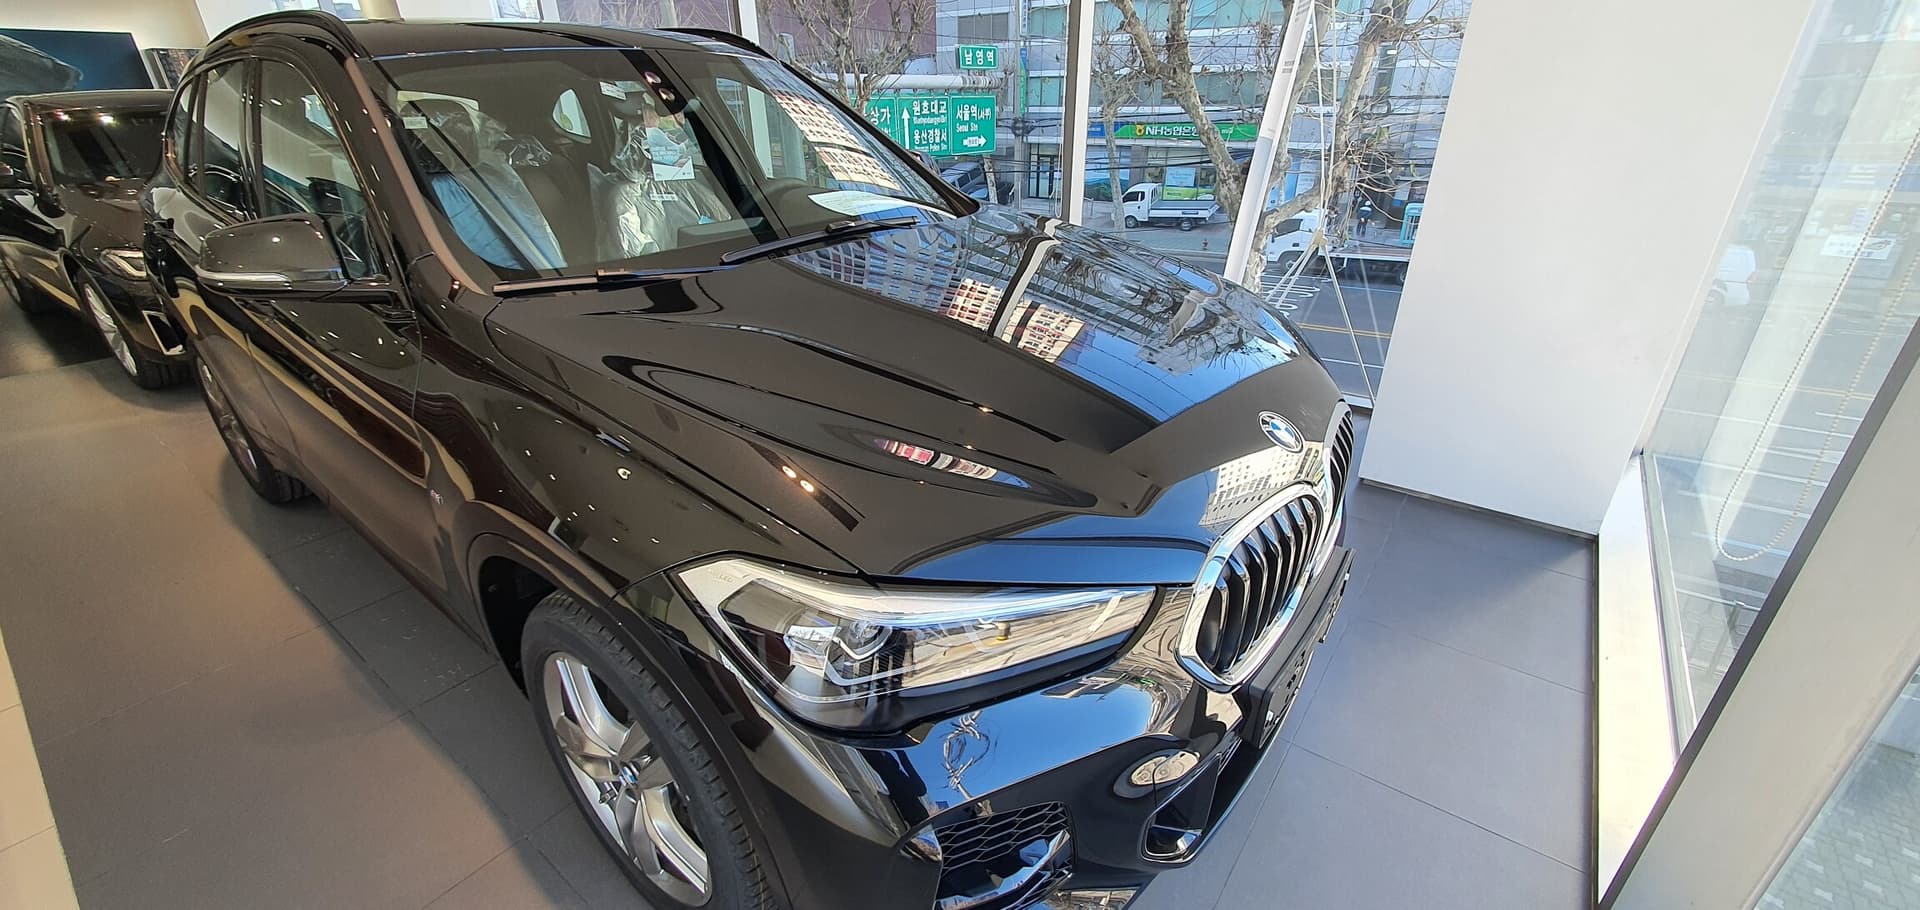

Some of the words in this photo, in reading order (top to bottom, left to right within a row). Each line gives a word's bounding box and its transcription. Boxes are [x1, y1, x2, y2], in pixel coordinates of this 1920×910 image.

[964, 48, 994, 66] 남영역
[914, 128, 947, 144] 용산경찰서
[956, 123, 969, 133] Seoul
